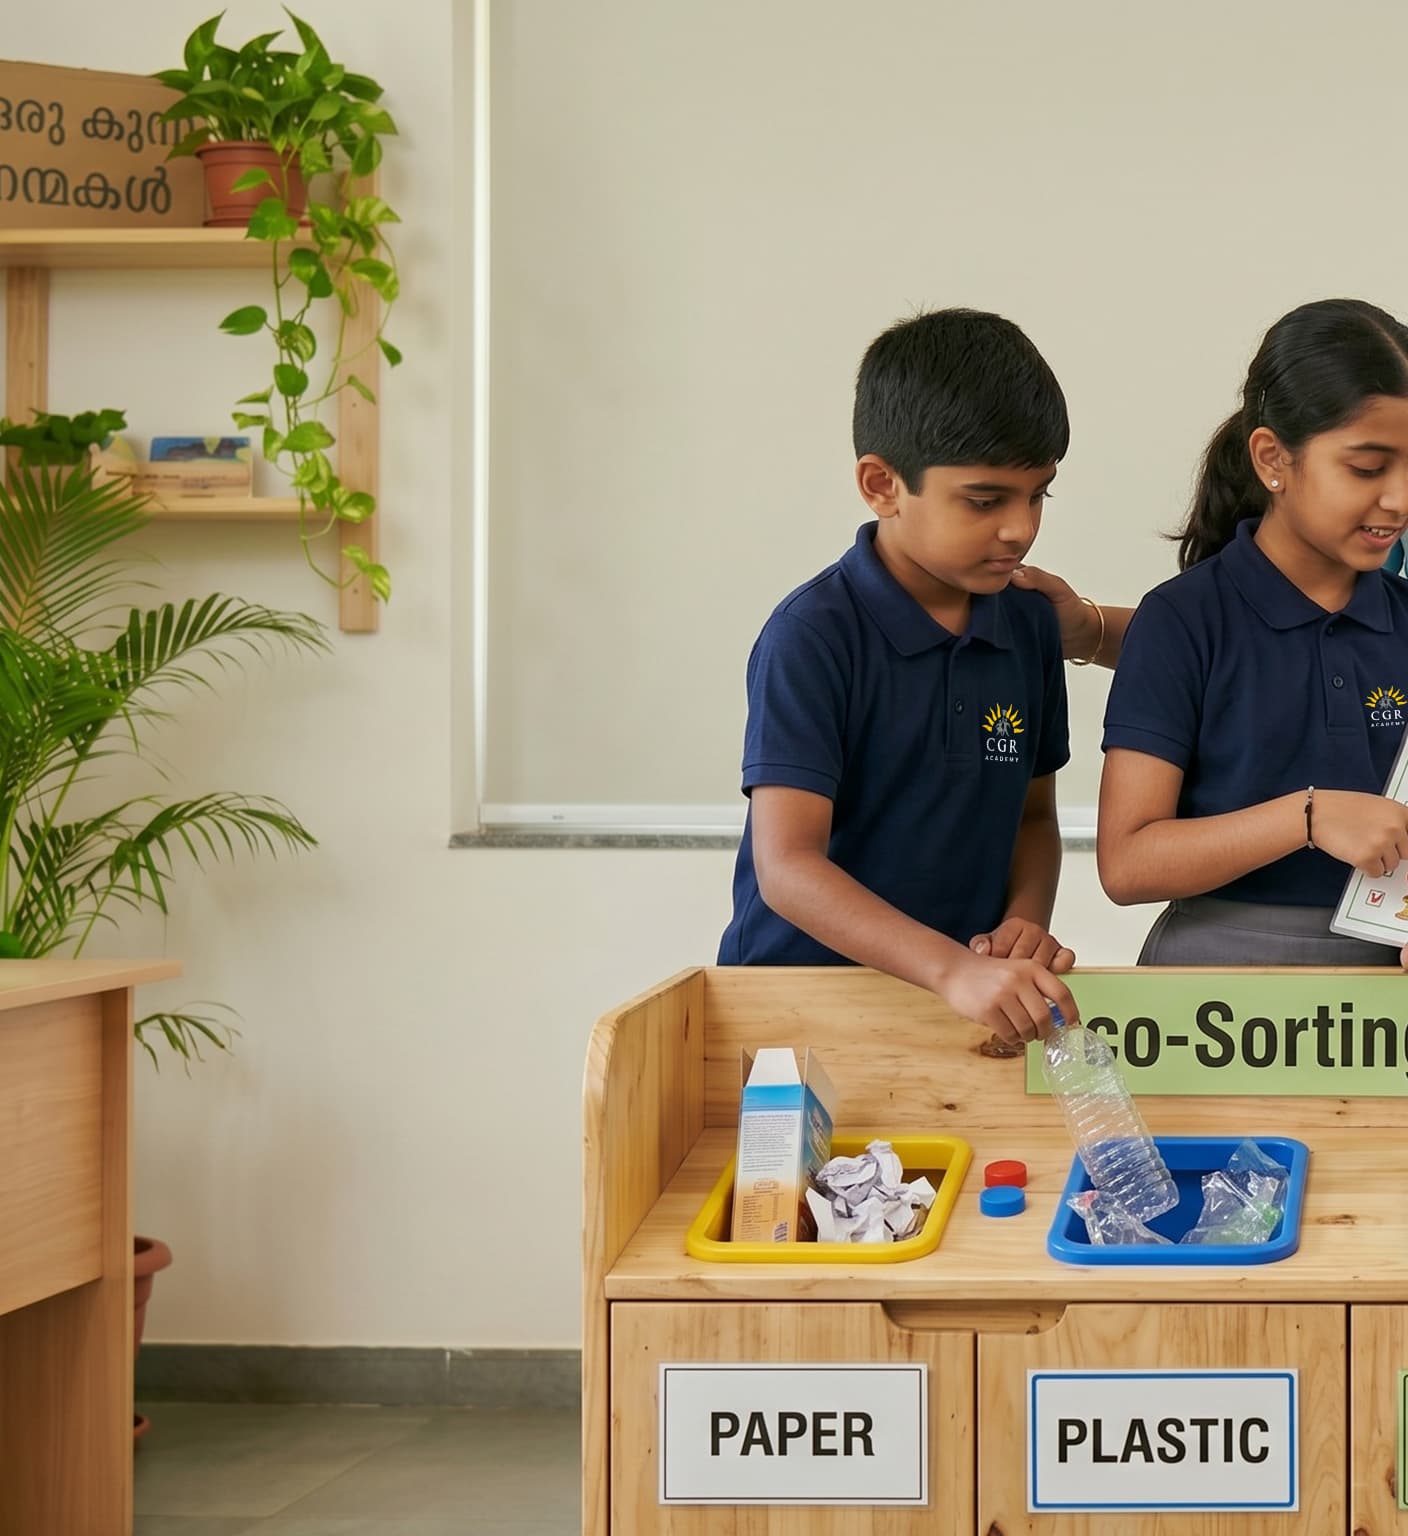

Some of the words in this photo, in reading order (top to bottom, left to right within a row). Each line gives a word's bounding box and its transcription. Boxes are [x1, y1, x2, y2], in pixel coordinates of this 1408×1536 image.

[1370, 709, 1403, 721] CGR
[986, 737, 1019, 754] CGR
[712, 1412, 874, 1456] PAPER
[1059, 1418, 1268, 1463] PLASTIC
